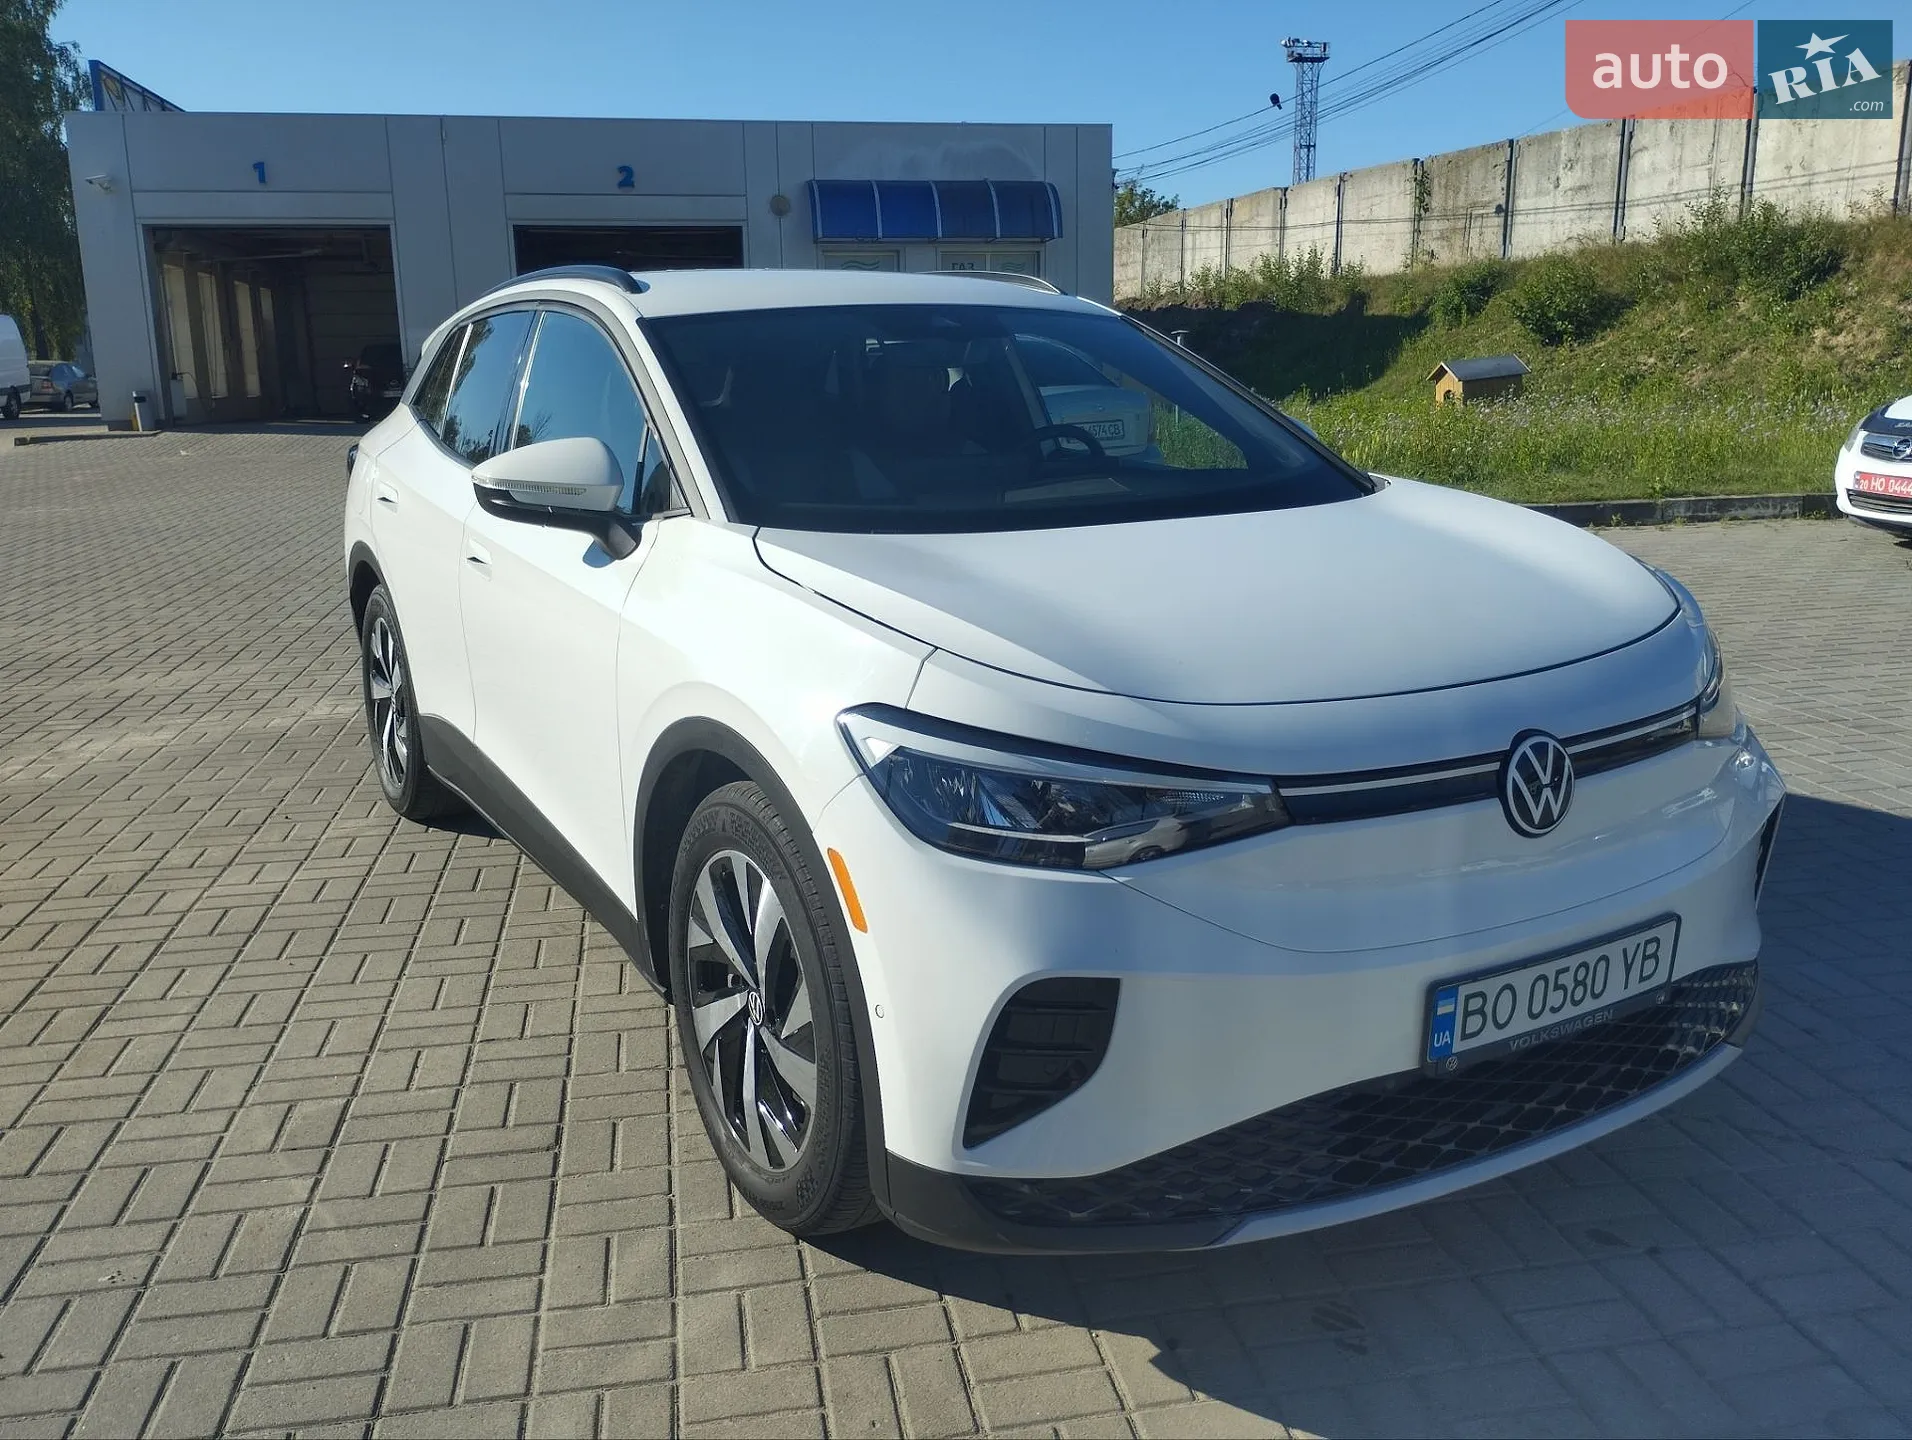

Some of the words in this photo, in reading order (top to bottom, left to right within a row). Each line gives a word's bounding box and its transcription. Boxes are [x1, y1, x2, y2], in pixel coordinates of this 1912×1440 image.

[252, 161, 266, 184] 1
[617, 165, 635, 189] 2
[1460, 984, 1517, 1041] BO
[1527, 954, 1609, 1020] 0580
[1622, 936, 1661, 990] YB
[1433, 1030, 1451, 1047] UA
[1508, 1008, 1614, 1052] VOLKSWAGEN
